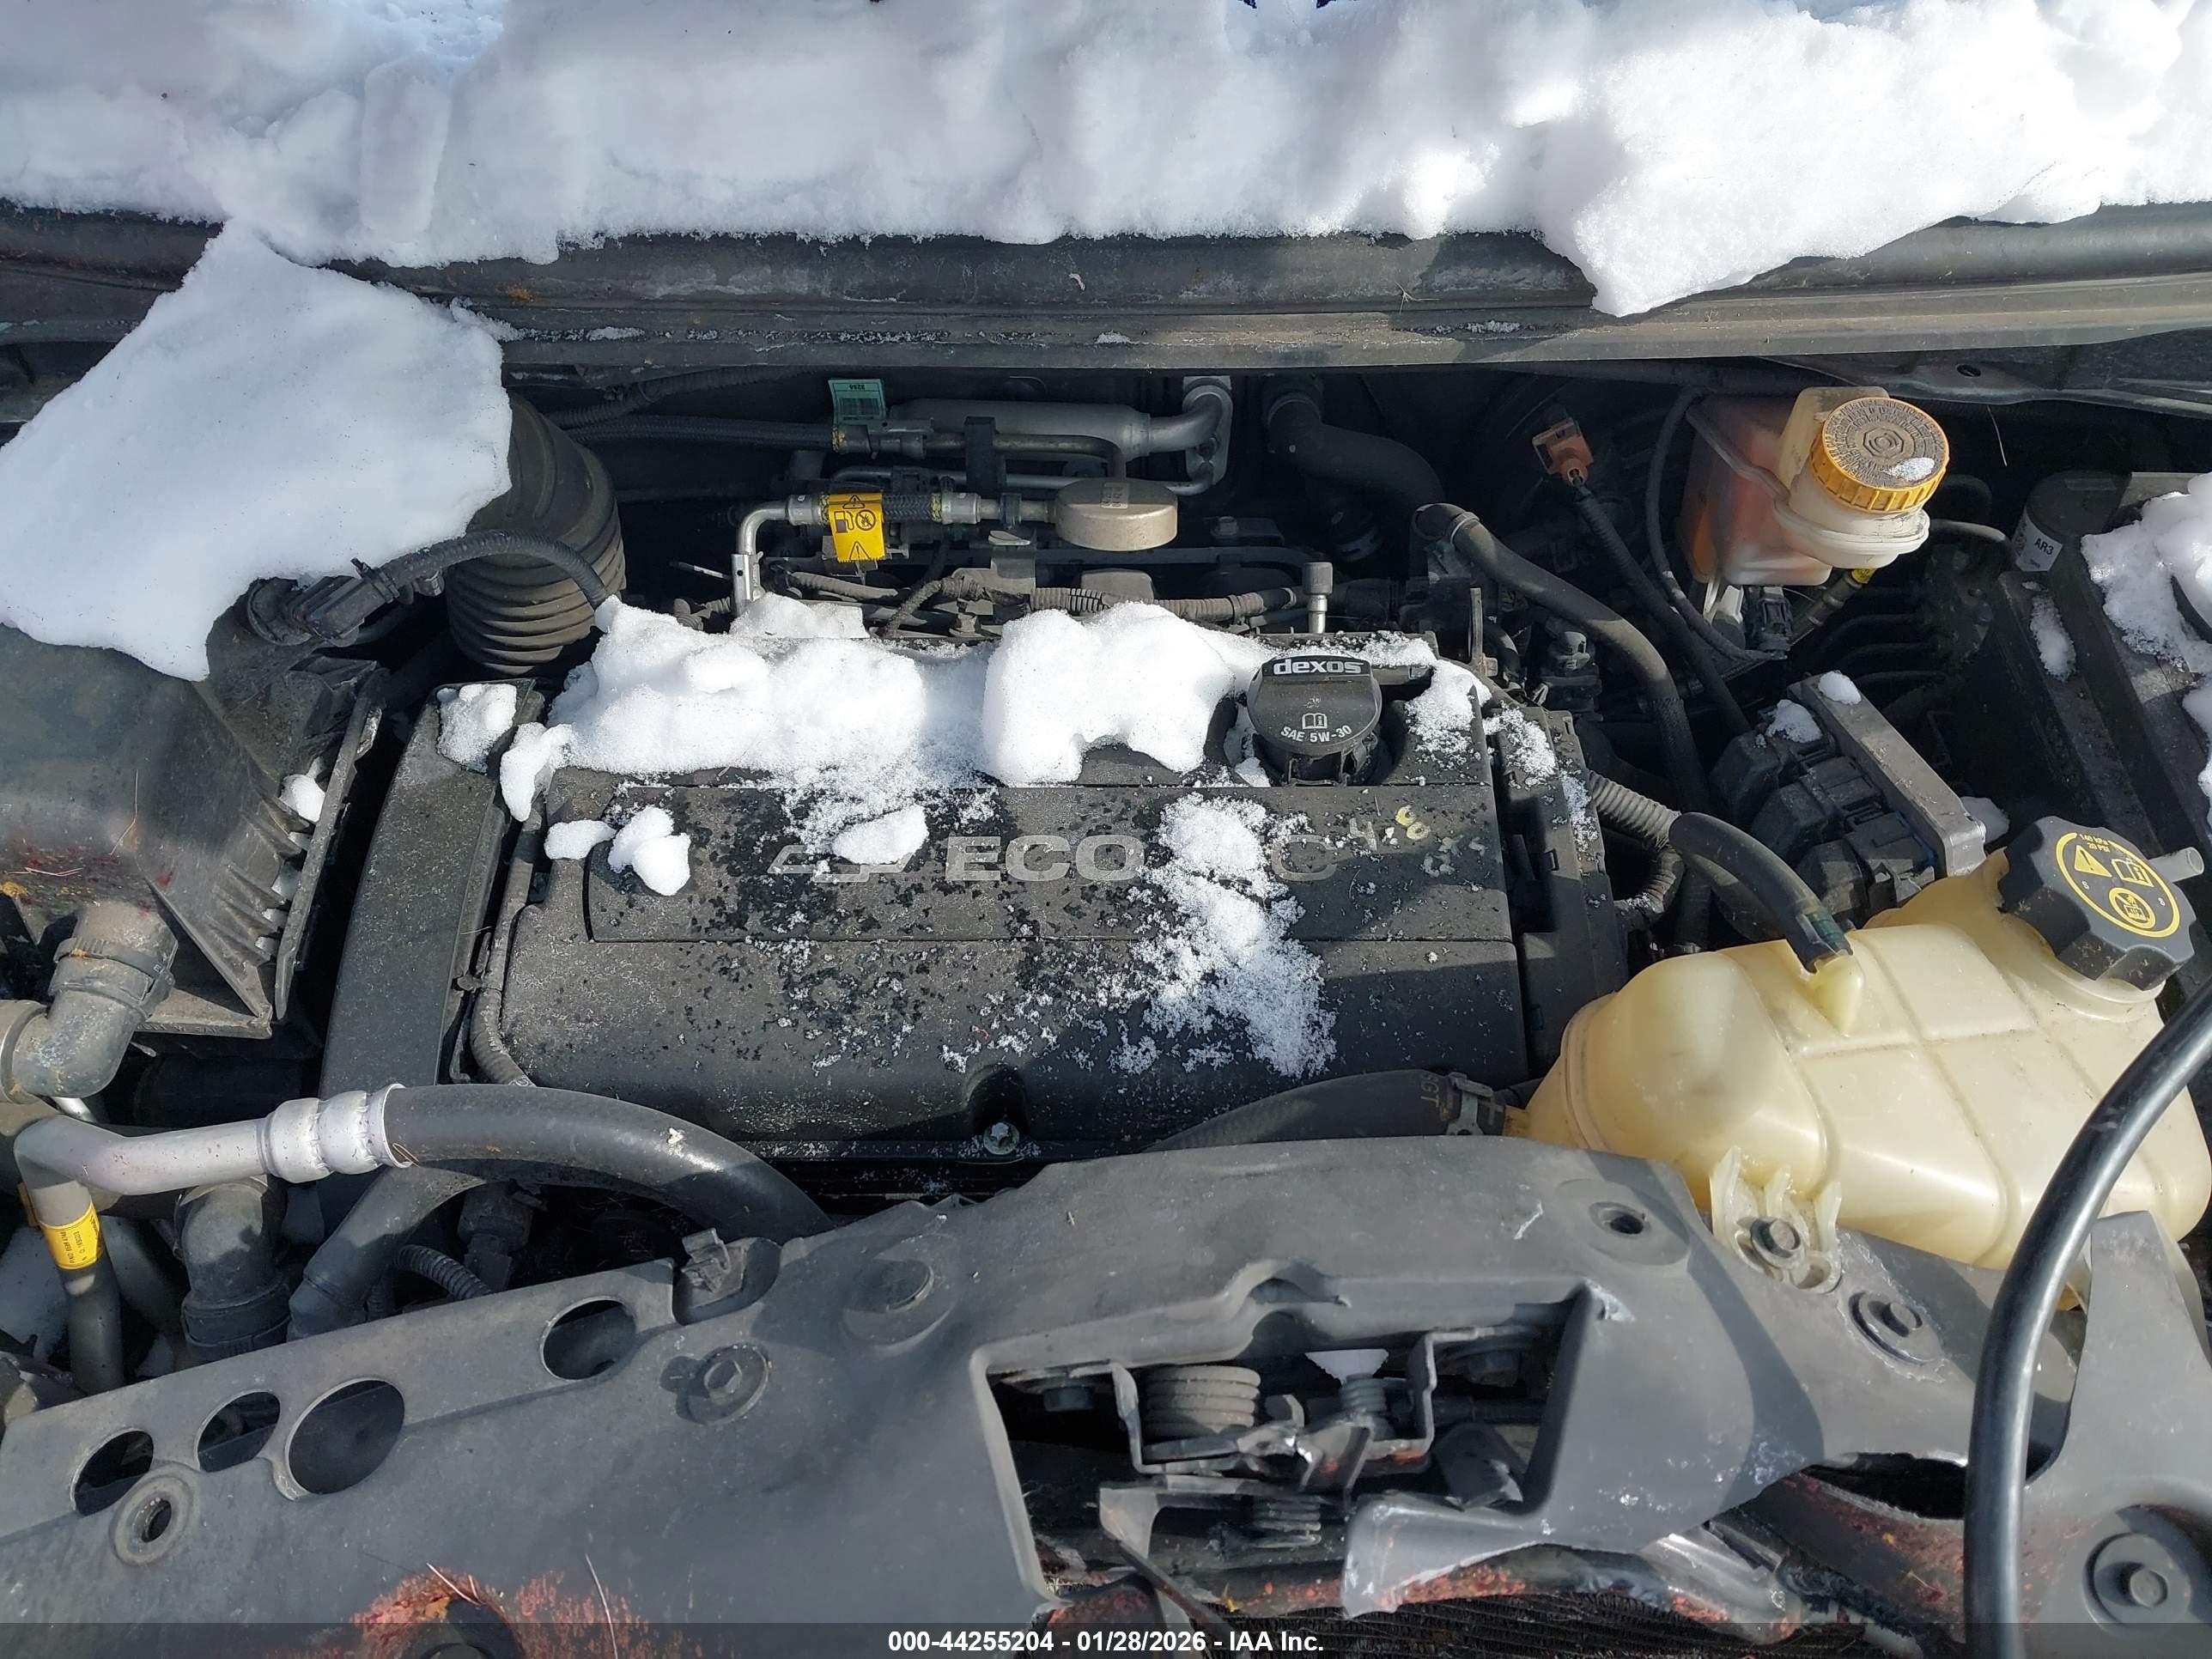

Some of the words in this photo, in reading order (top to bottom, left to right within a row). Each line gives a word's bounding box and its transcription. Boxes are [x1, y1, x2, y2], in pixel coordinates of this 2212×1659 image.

[2033, 538, 2054, 556] AR3
[1273, 659, 1364, 675] dexos
[1280, 726, 1305, 743] SAE
[1310, 724, 1352, 743] 5W-30
[945, 834, 1338, 882] ECOC
